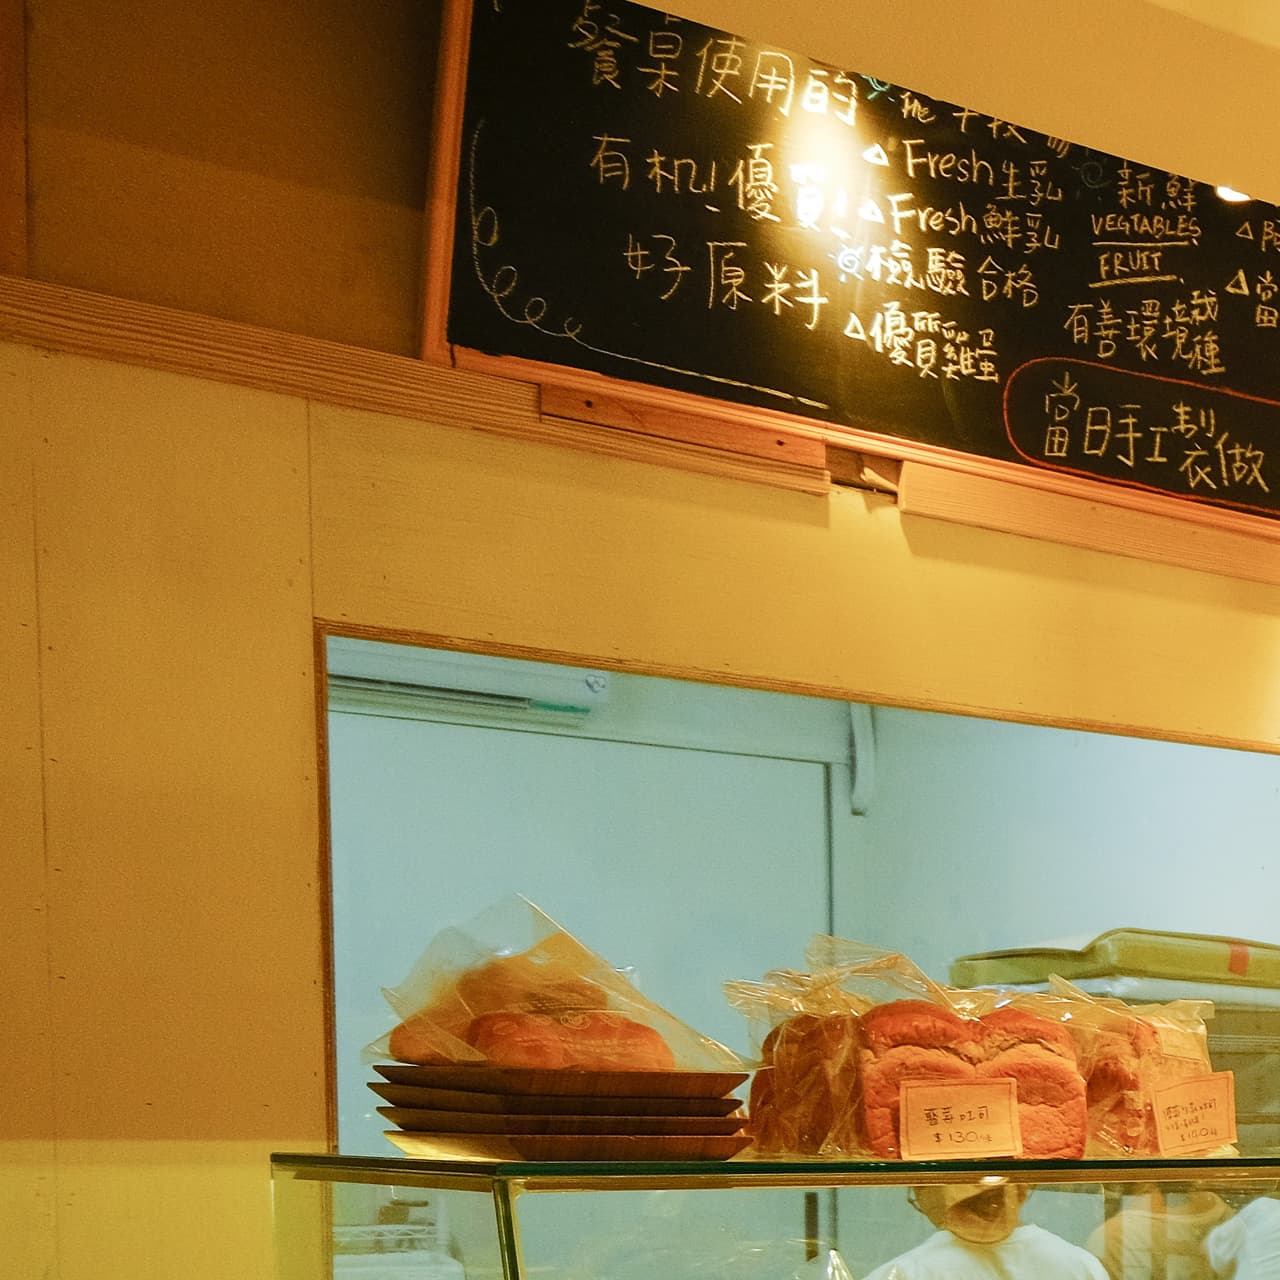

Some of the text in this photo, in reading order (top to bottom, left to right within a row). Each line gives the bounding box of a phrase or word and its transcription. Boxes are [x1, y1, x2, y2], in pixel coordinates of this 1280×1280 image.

[901, 139, 994, 186] Fresh
[886, 191, 1060, 254] Fresh 鮮乳
[624, 233, 829, 332] 好原料
[1098, 250, 1163, 280] FRUIT
